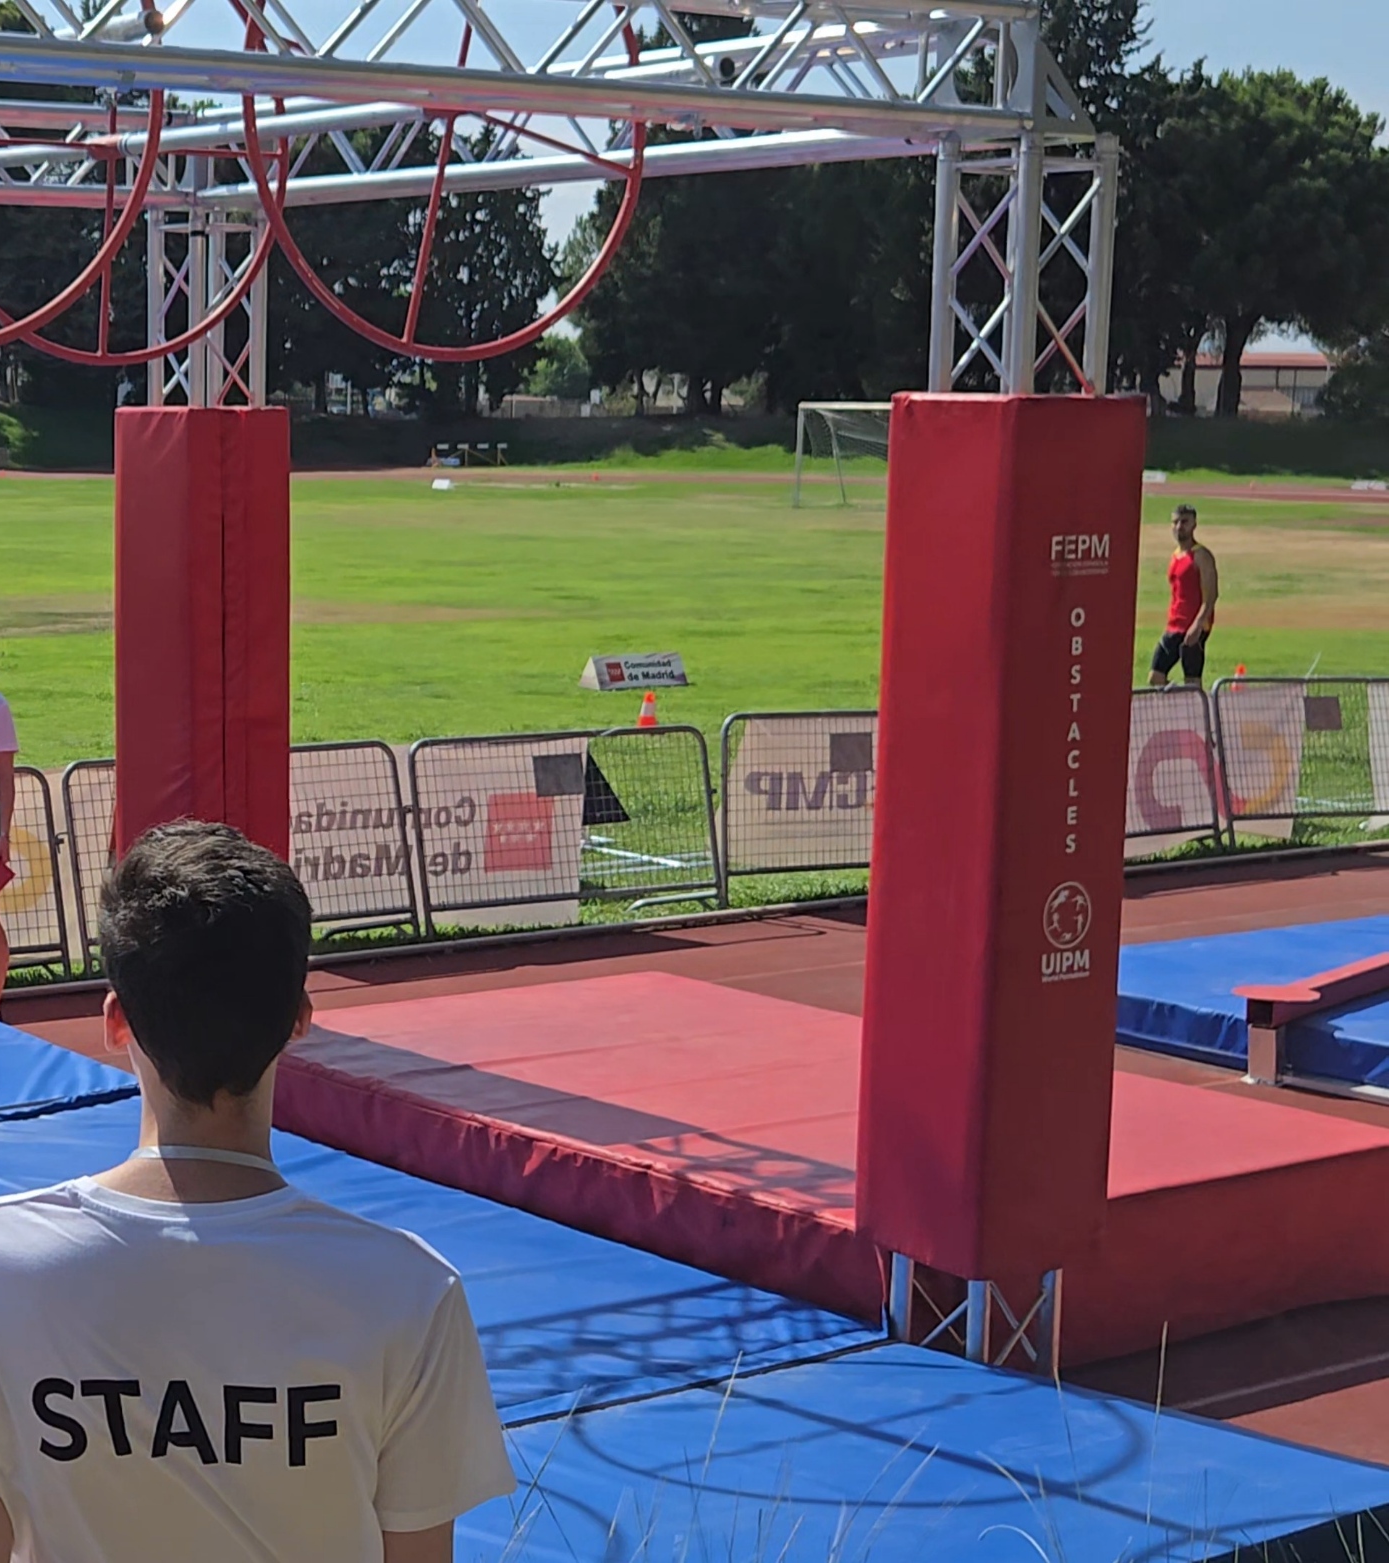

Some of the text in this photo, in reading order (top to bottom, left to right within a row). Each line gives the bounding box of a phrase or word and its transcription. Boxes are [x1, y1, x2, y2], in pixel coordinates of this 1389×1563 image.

[1051, 533, 1110, 561] FEPM
[623, 659, 672, 670] Comunidad
[626, 670, 676, 681] de Madrid
[1065, 606, 1086, 855] OBSTACLES
[1041, 949, 1090, 975] UIPM
[32, 1377, 341, 1466] STAFF
